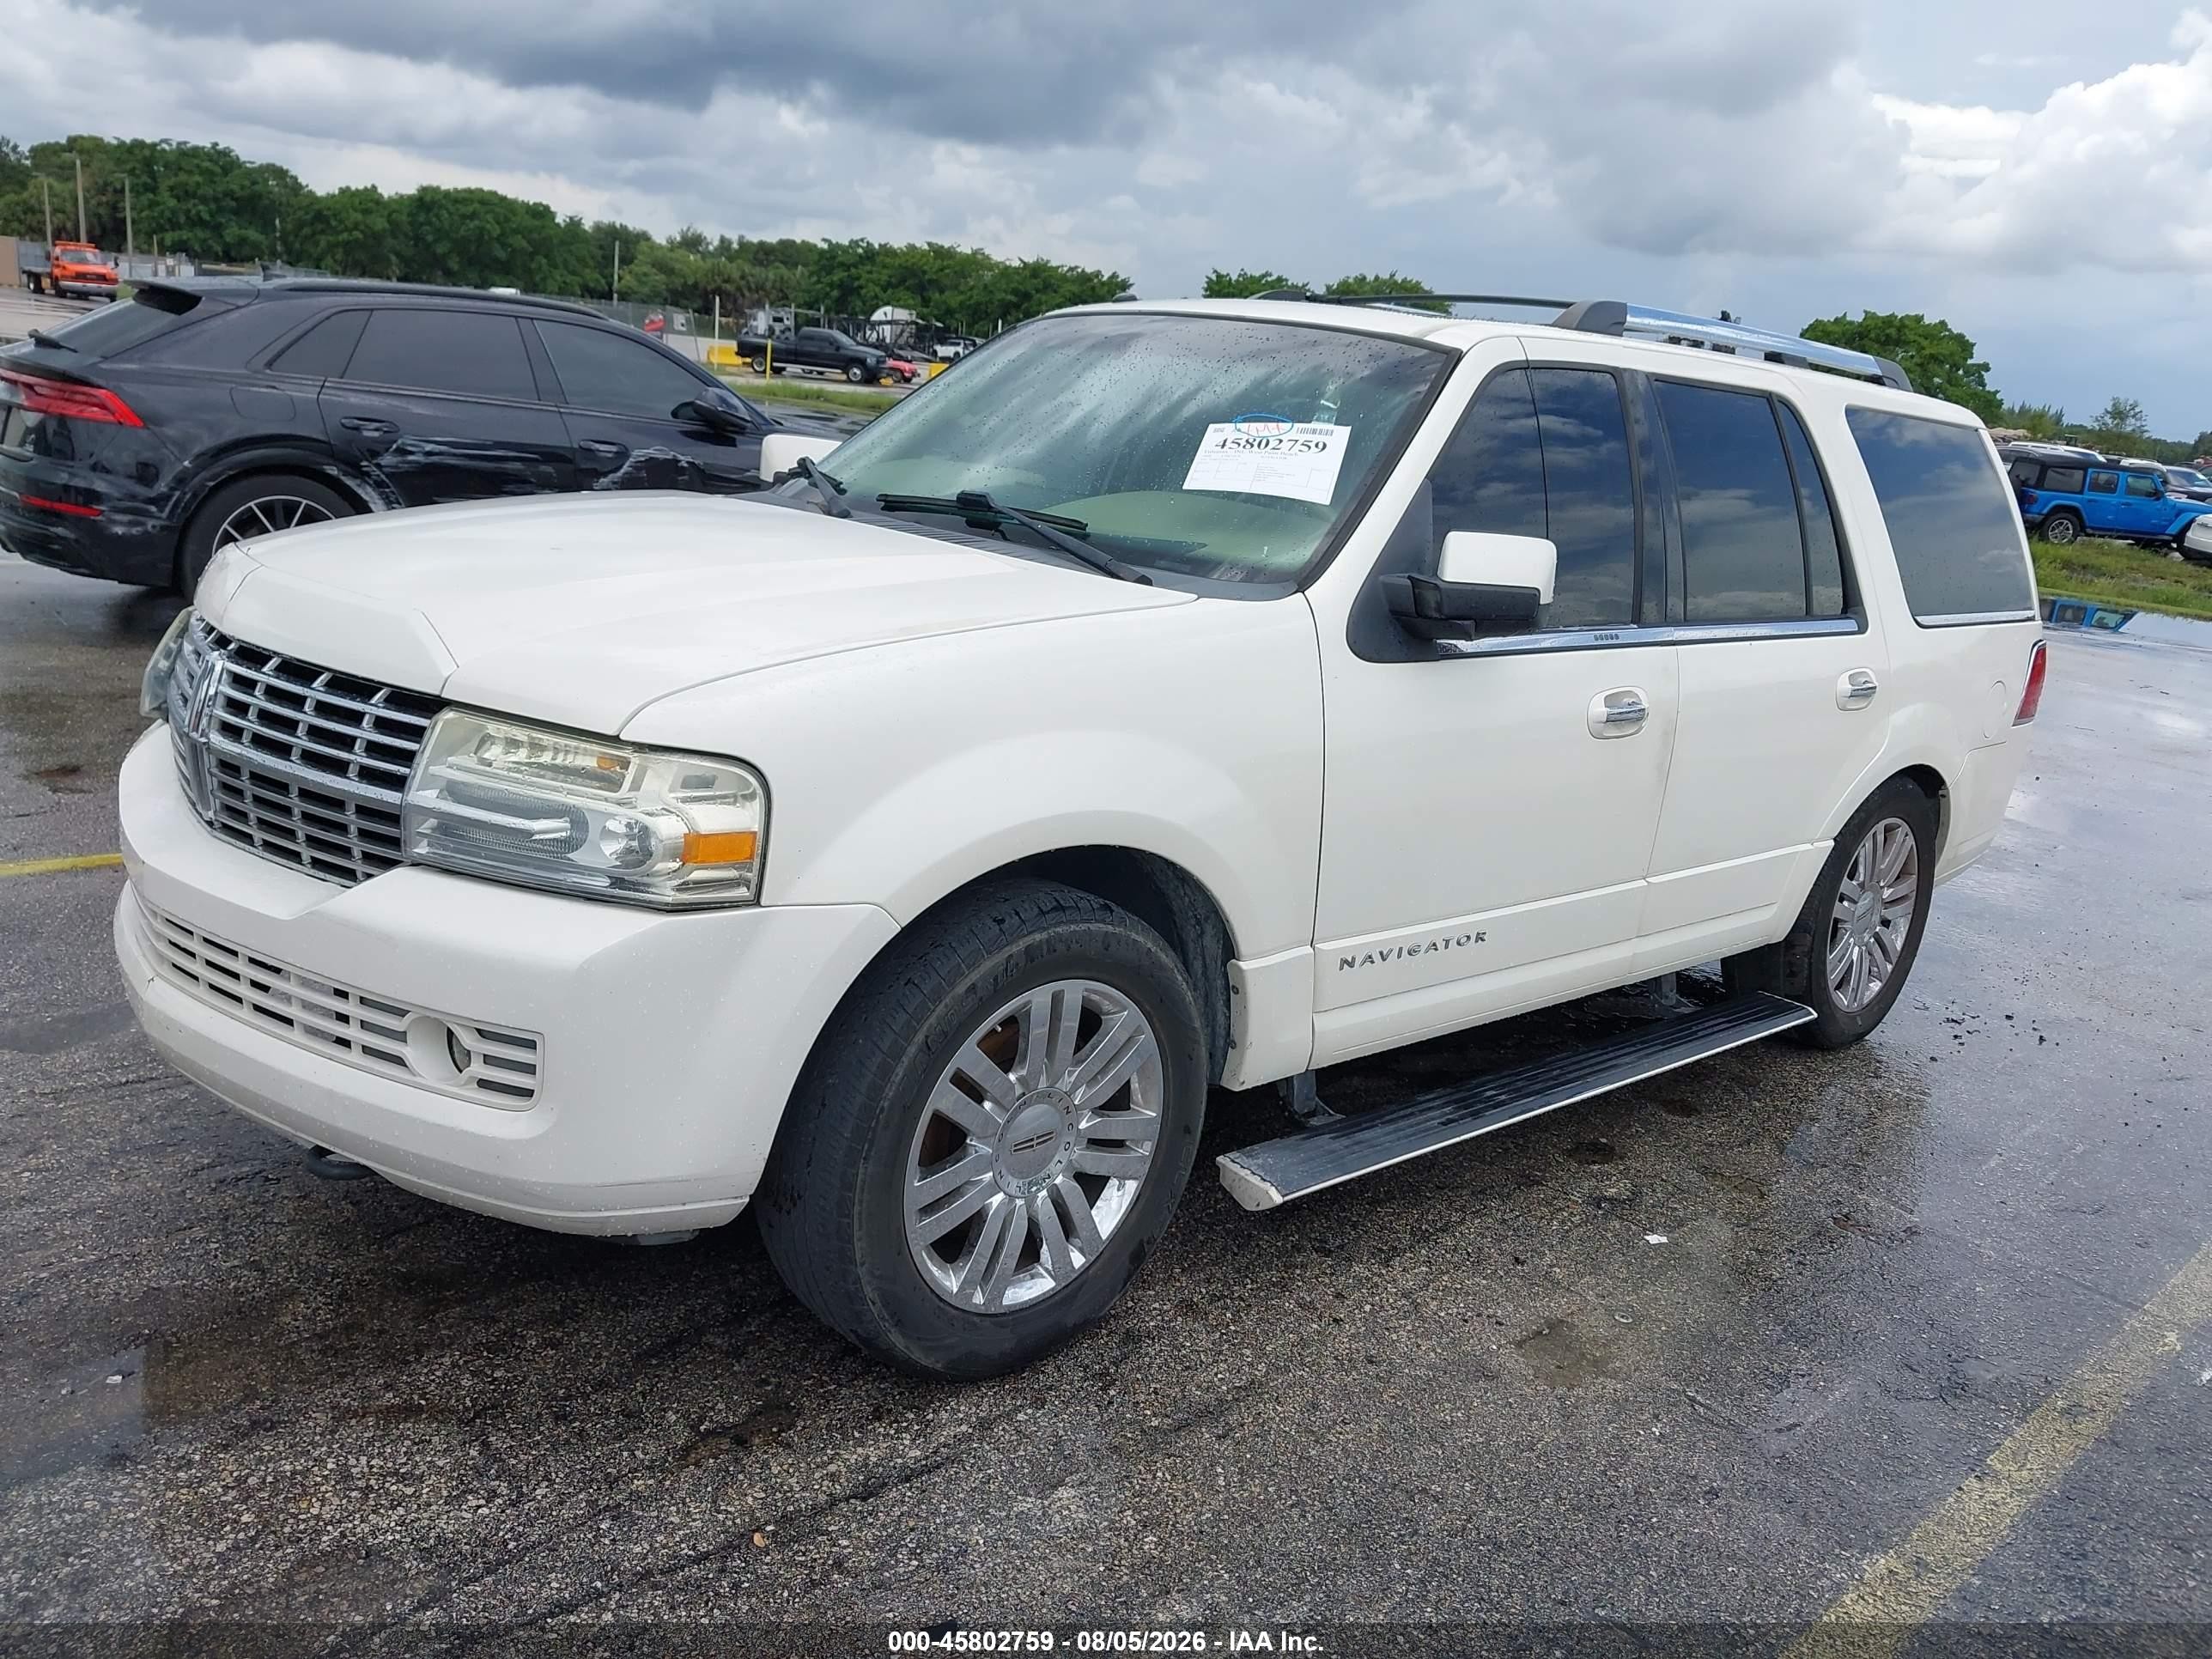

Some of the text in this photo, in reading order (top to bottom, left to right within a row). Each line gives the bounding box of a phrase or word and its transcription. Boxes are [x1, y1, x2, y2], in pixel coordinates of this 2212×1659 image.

[1214, 437, 1328, 454] 45802759
[1339, 930, 1487, 971] NAVIGATOR
[1042, 1092, 1074, 1183] LINCOLN
